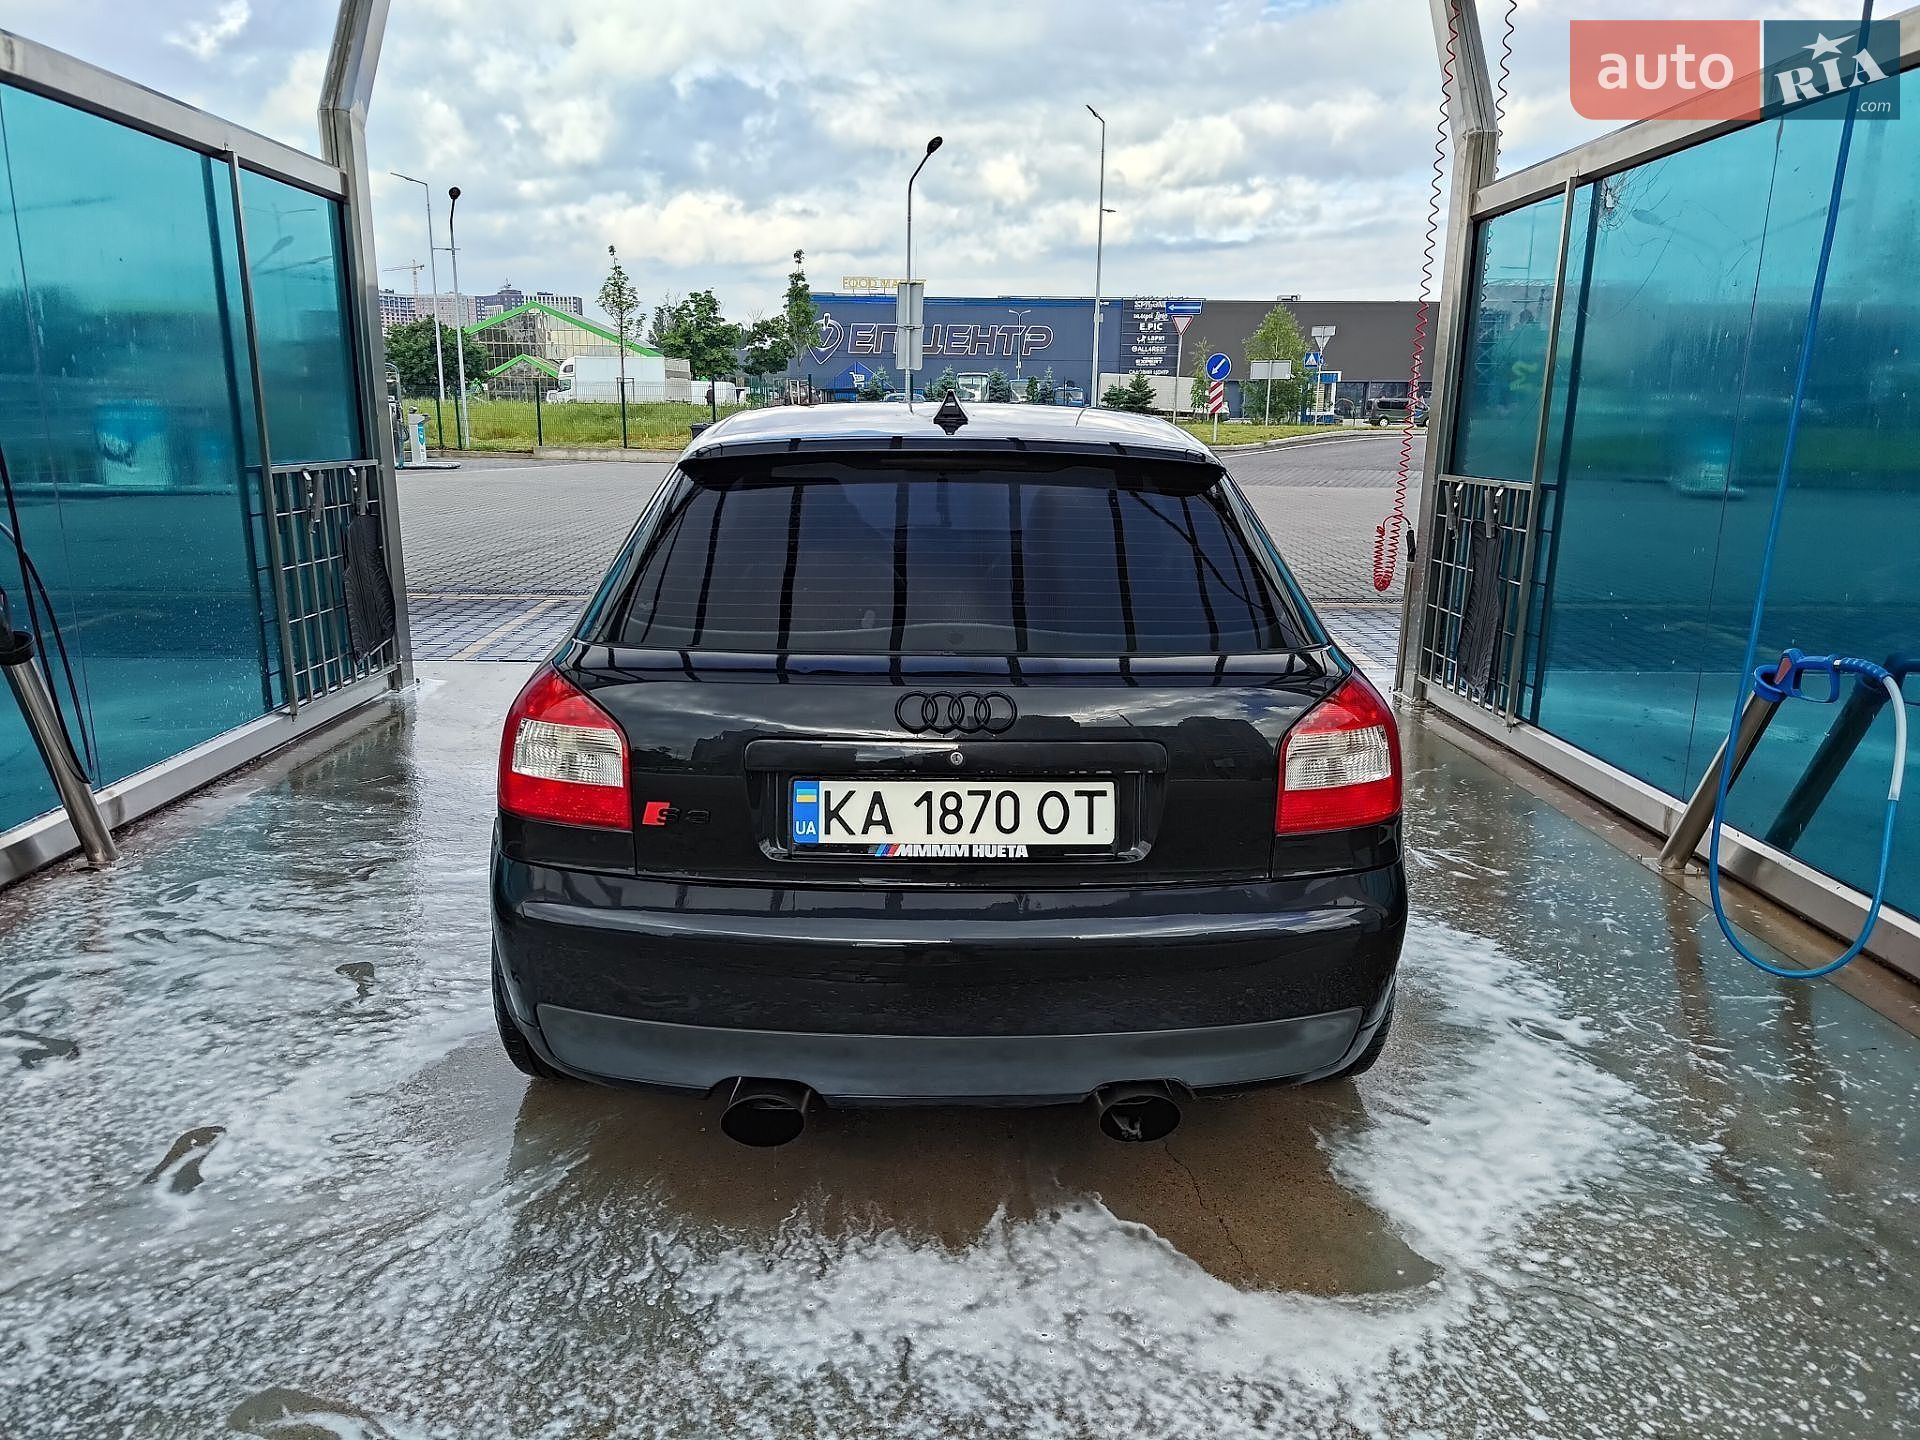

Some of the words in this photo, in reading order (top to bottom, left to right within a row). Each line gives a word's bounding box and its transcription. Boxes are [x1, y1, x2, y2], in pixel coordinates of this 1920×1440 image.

[824, 790, 894, 835] KA
[913, 790, 1020, 835] 1870
[1037, 790, 1107, 835] OT
[795, 821, 816, 835] UA
[972, 845, 1029, 858] HUETA
